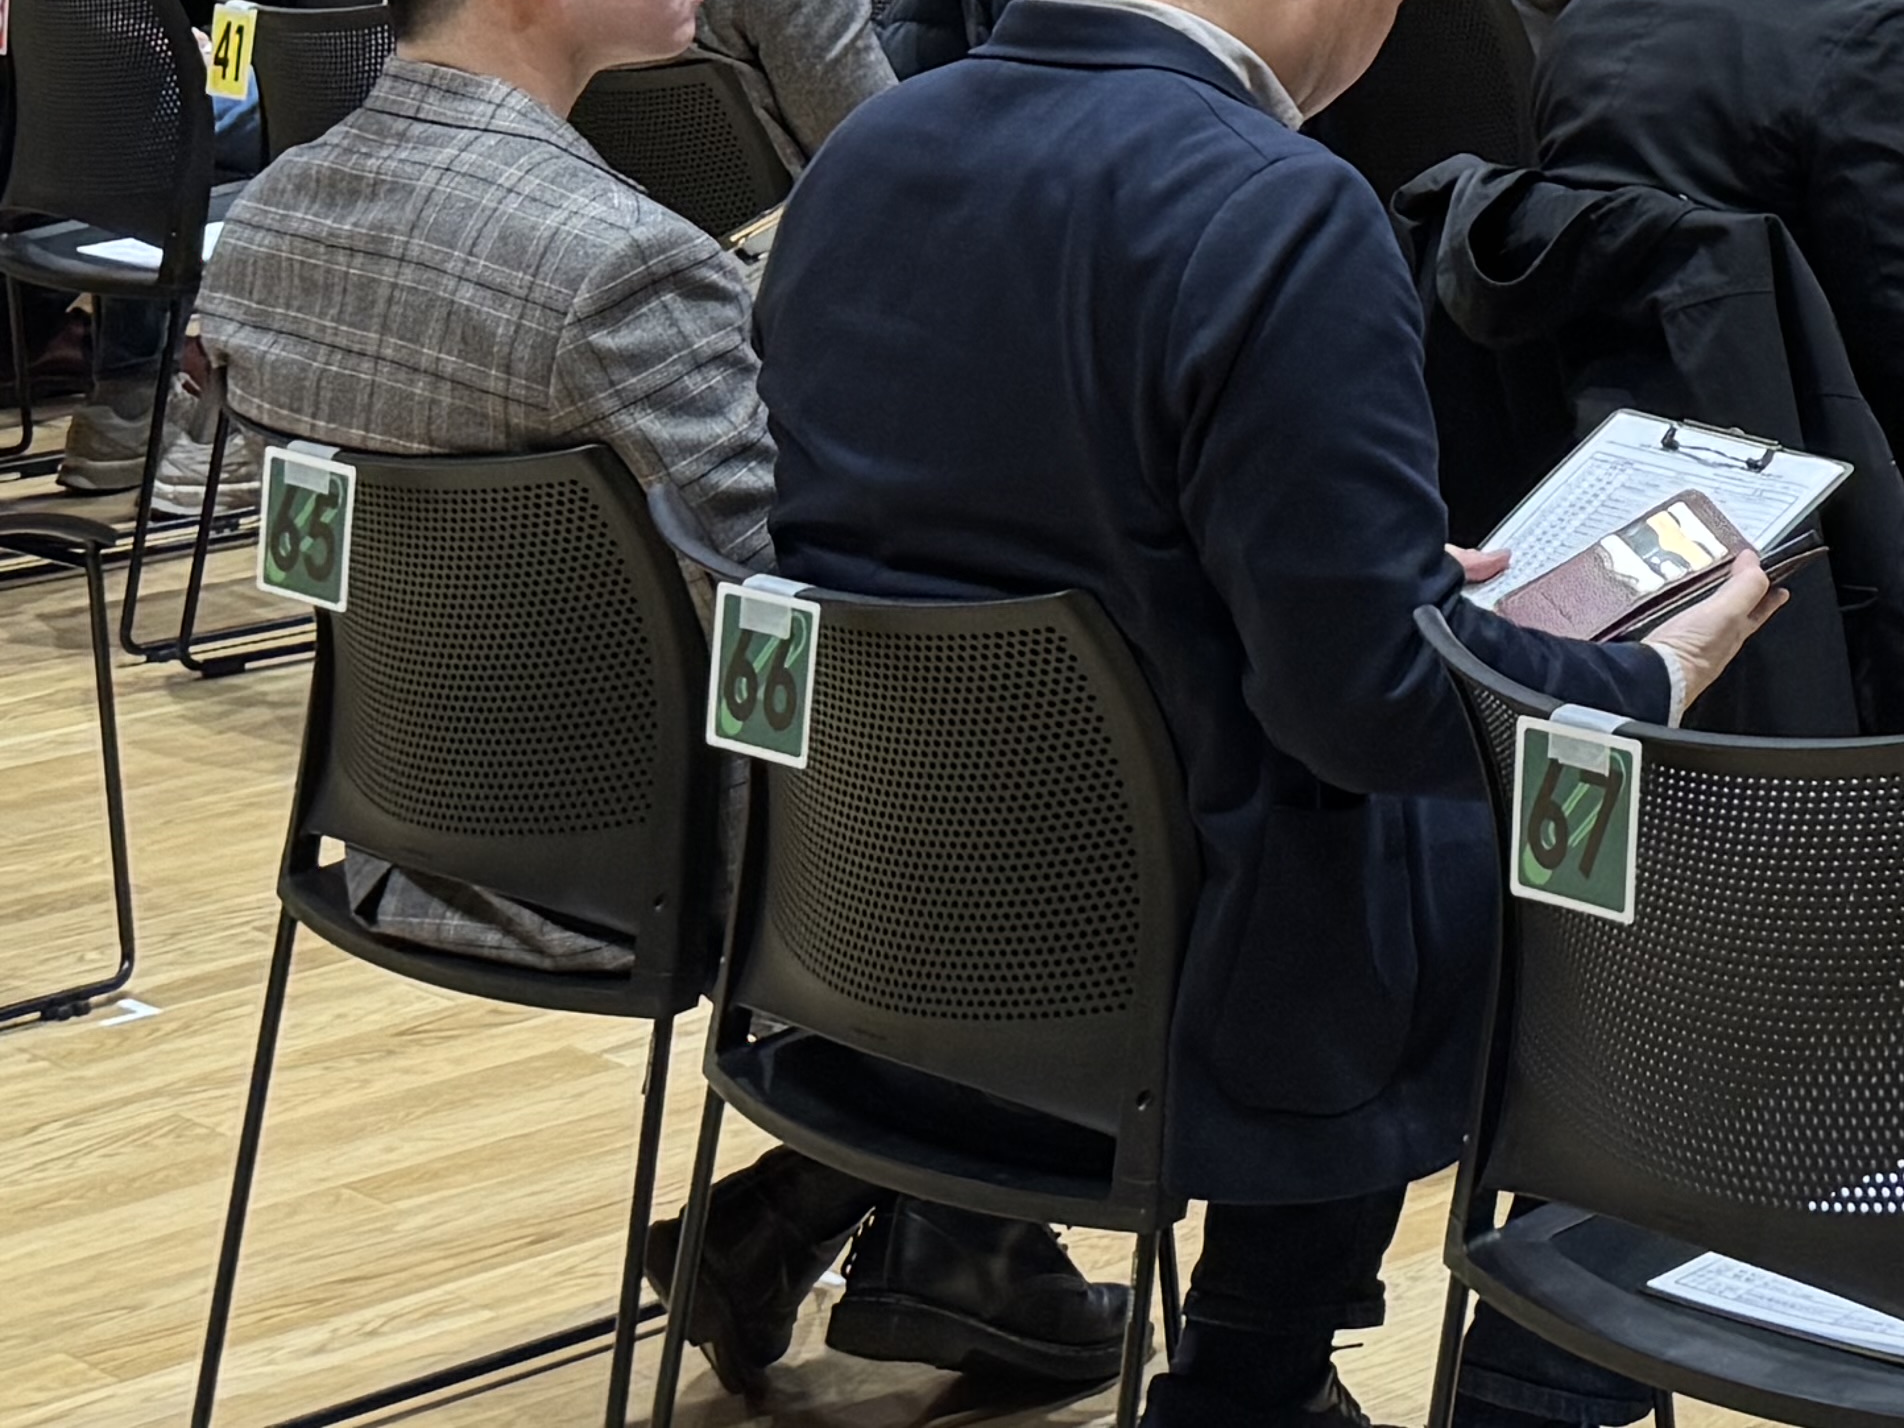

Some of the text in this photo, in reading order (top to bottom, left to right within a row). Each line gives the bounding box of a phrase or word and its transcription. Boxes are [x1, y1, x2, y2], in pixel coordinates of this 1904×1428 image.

[214, 20, 244, 82] 41
[271, 482, 338, 582] 65
[724, 618, 797, 731] 66
[1528, 757, 1625, 879] 67
